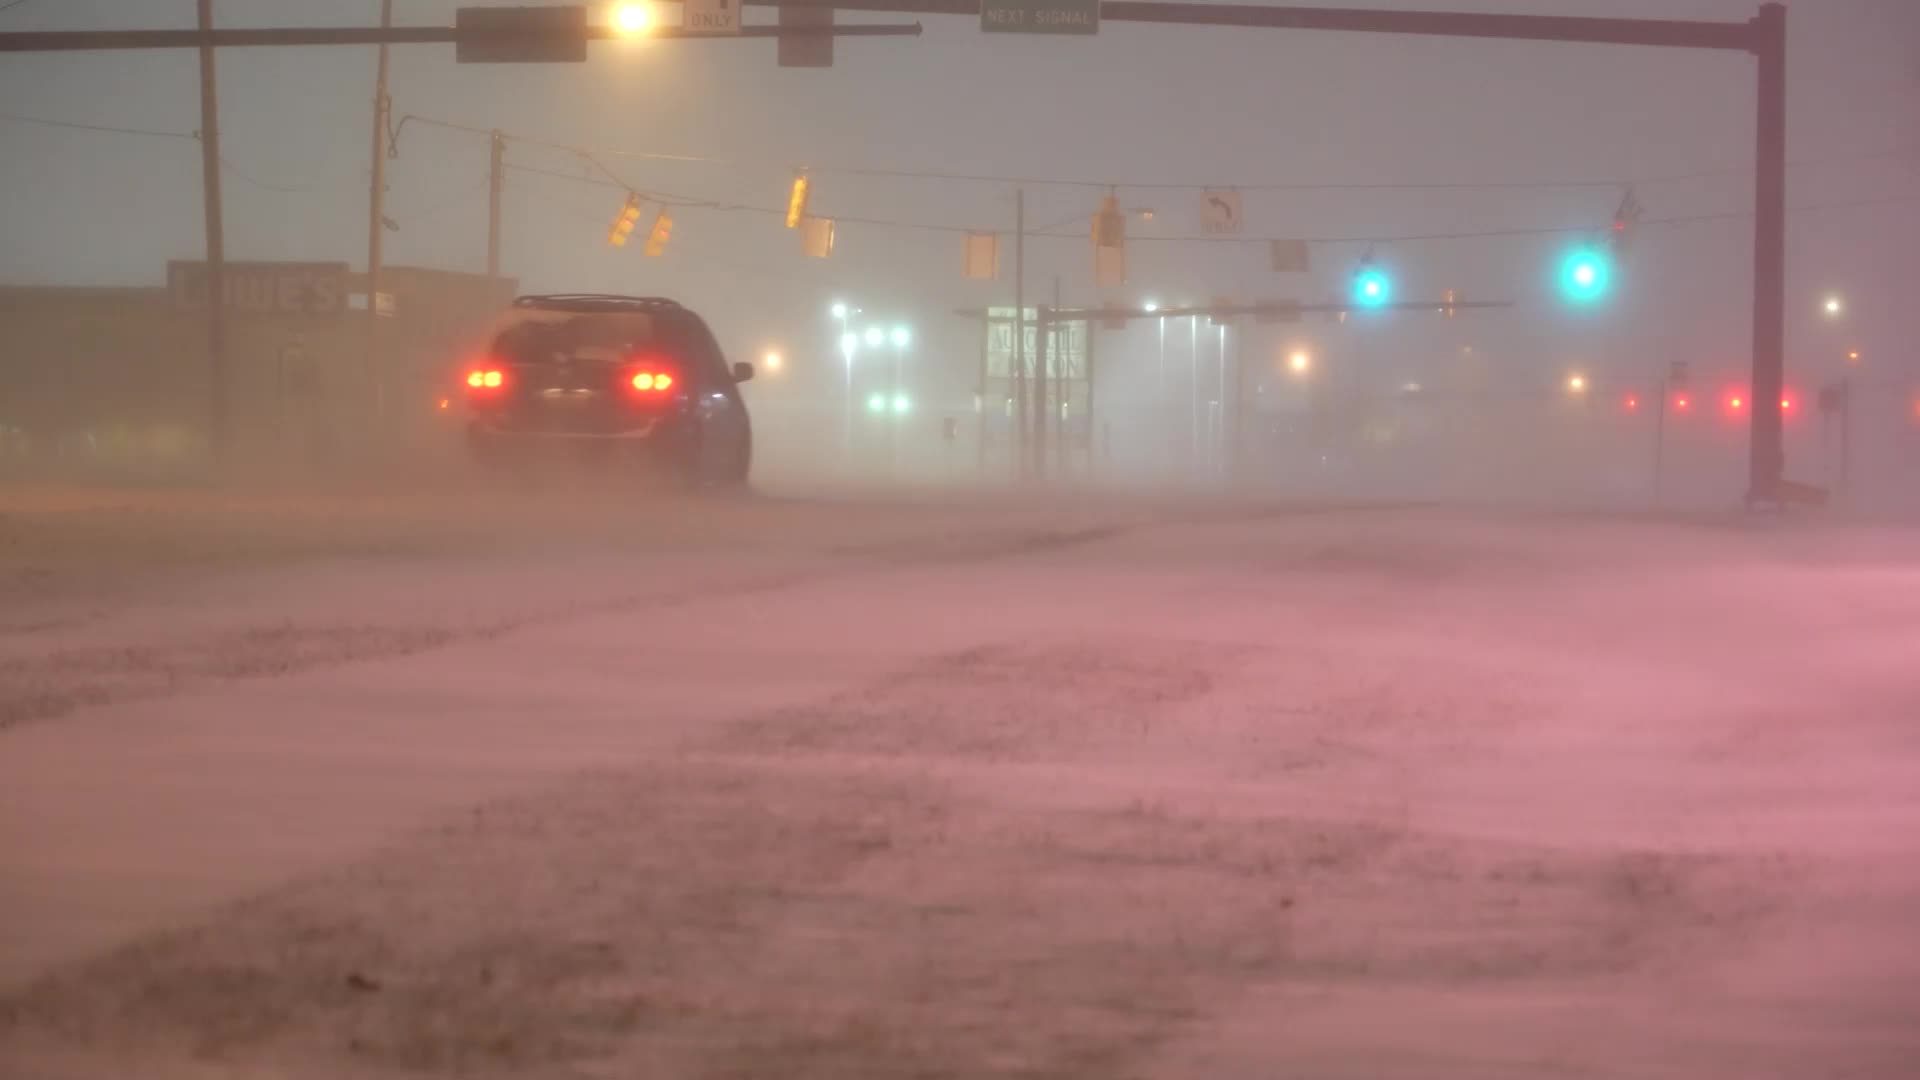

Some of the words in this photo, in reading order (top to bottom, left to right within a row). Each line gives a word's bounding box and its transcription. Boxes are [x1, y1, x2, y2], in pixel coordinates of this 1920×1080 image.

[691, 13, 732, 27] ONLY
[987, 8, 1024, 24] NEXT
[1035, 8, 1089, 25] SIGNAL
